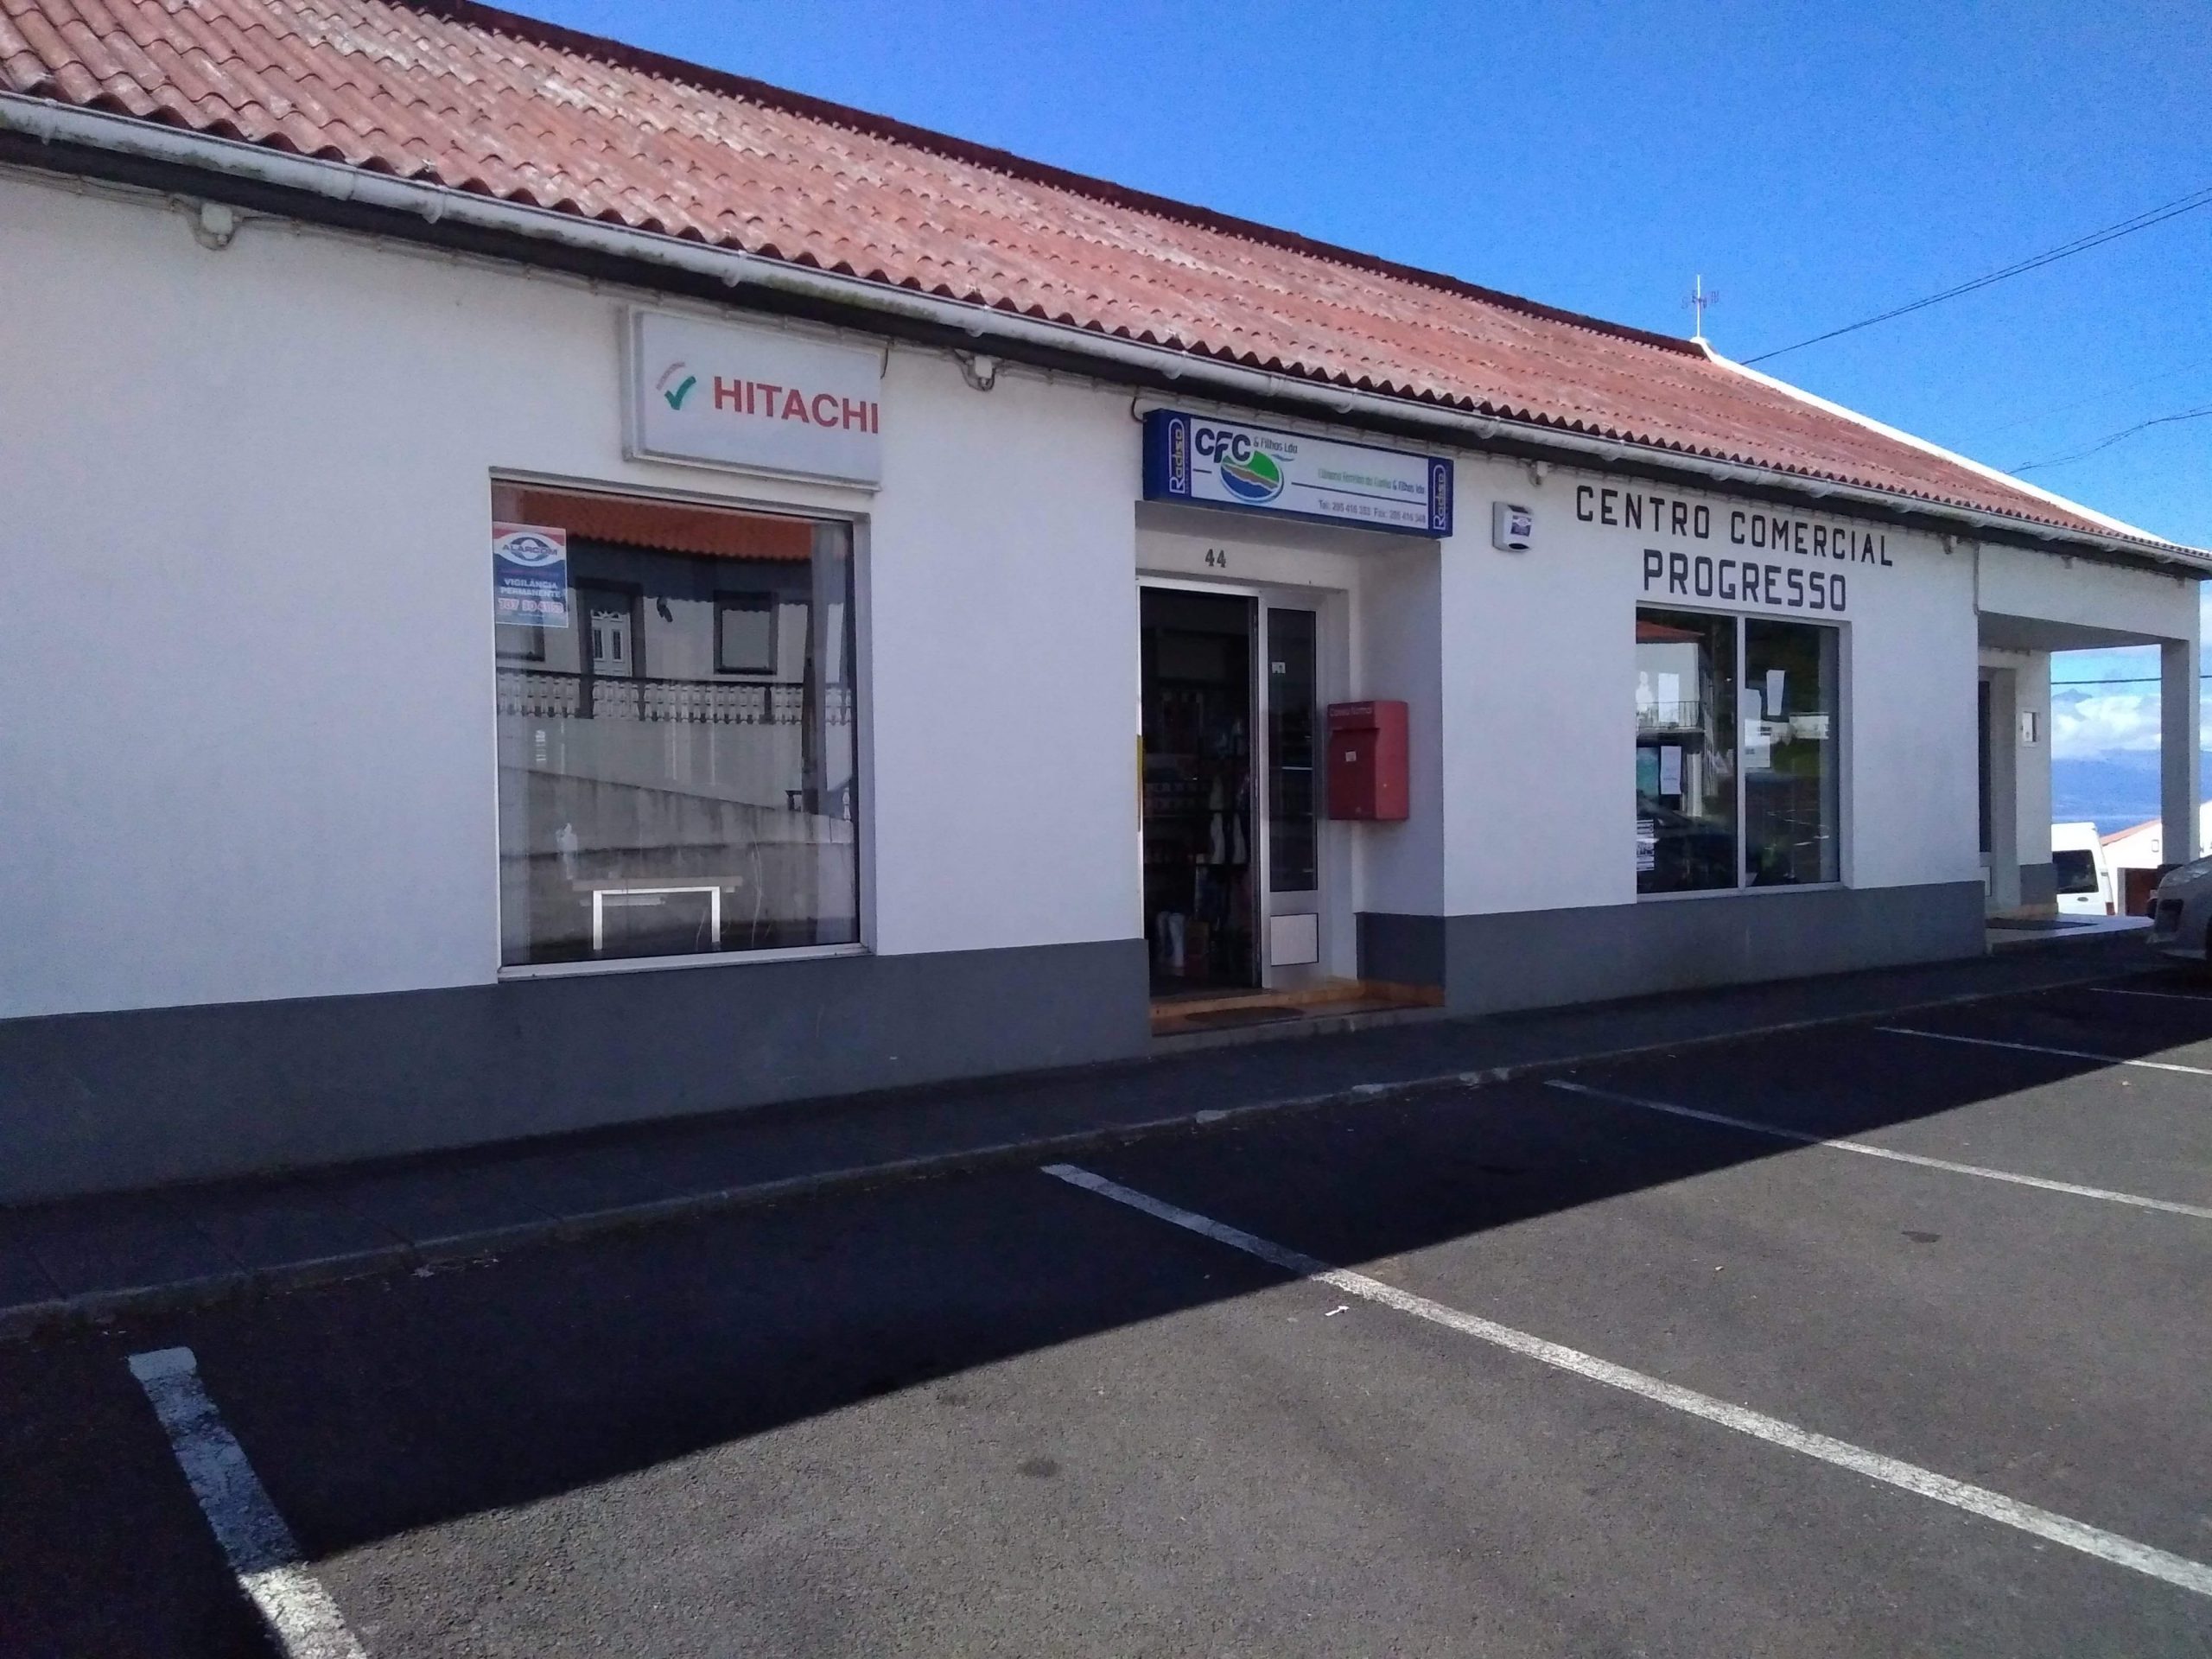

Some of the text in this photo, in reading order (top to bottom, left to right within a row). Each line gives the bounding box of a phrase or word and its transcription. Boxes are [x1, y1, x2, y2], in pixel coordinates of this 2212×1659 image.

[714, 376, 878, 434] HITACHI
[1195, 428, 1251, 463] CFC
[1261, 437, 1283, 451] Filhos
[1576, 485, 1893, 567] CENTRO COMERCIAL
[502, 544, 558, 556] ALARCOM
[1205, 549, 1226, 569] 44
[500, 587, 562, 598] PERMANENTE
[1643, 549, 1847, 612] PROGRESSO
